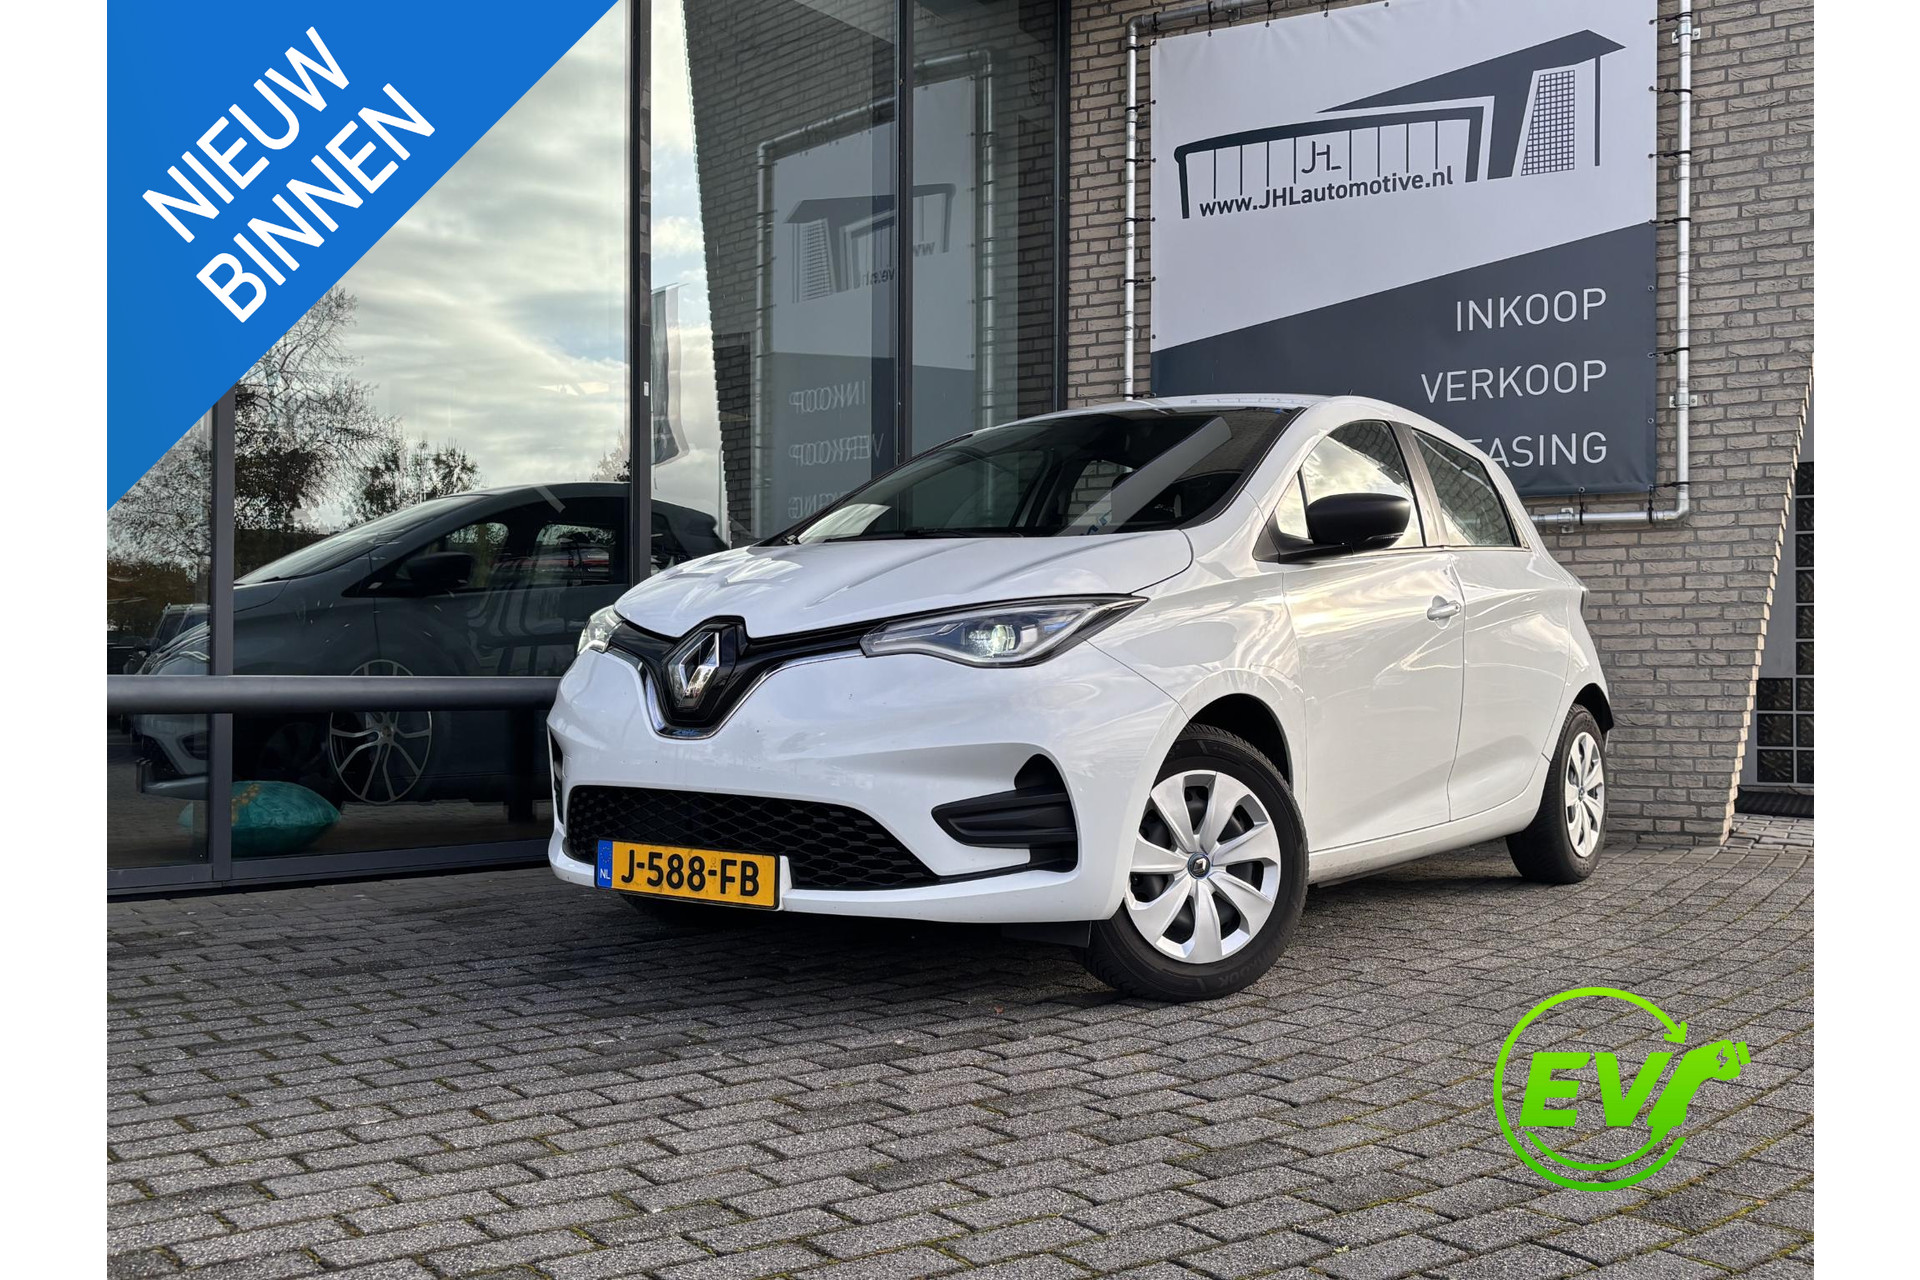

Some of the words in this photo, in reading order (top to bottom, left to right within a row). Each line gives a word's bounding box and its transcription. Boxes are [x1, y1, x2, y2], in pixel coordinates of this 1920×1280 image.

[1301, 141, 1342, 174] JHL
[1199, 165, 1454, 217] www.JHLautomotive.nl
[1457, 287, 1607, 332] INKOOP
[1421, 359, 1607, 404] VERKOOP
[1466, 431, 1607, 468] ASING
[599, 867, 611, 880] NL
[621, 849, 760, 897] J-588-FB
